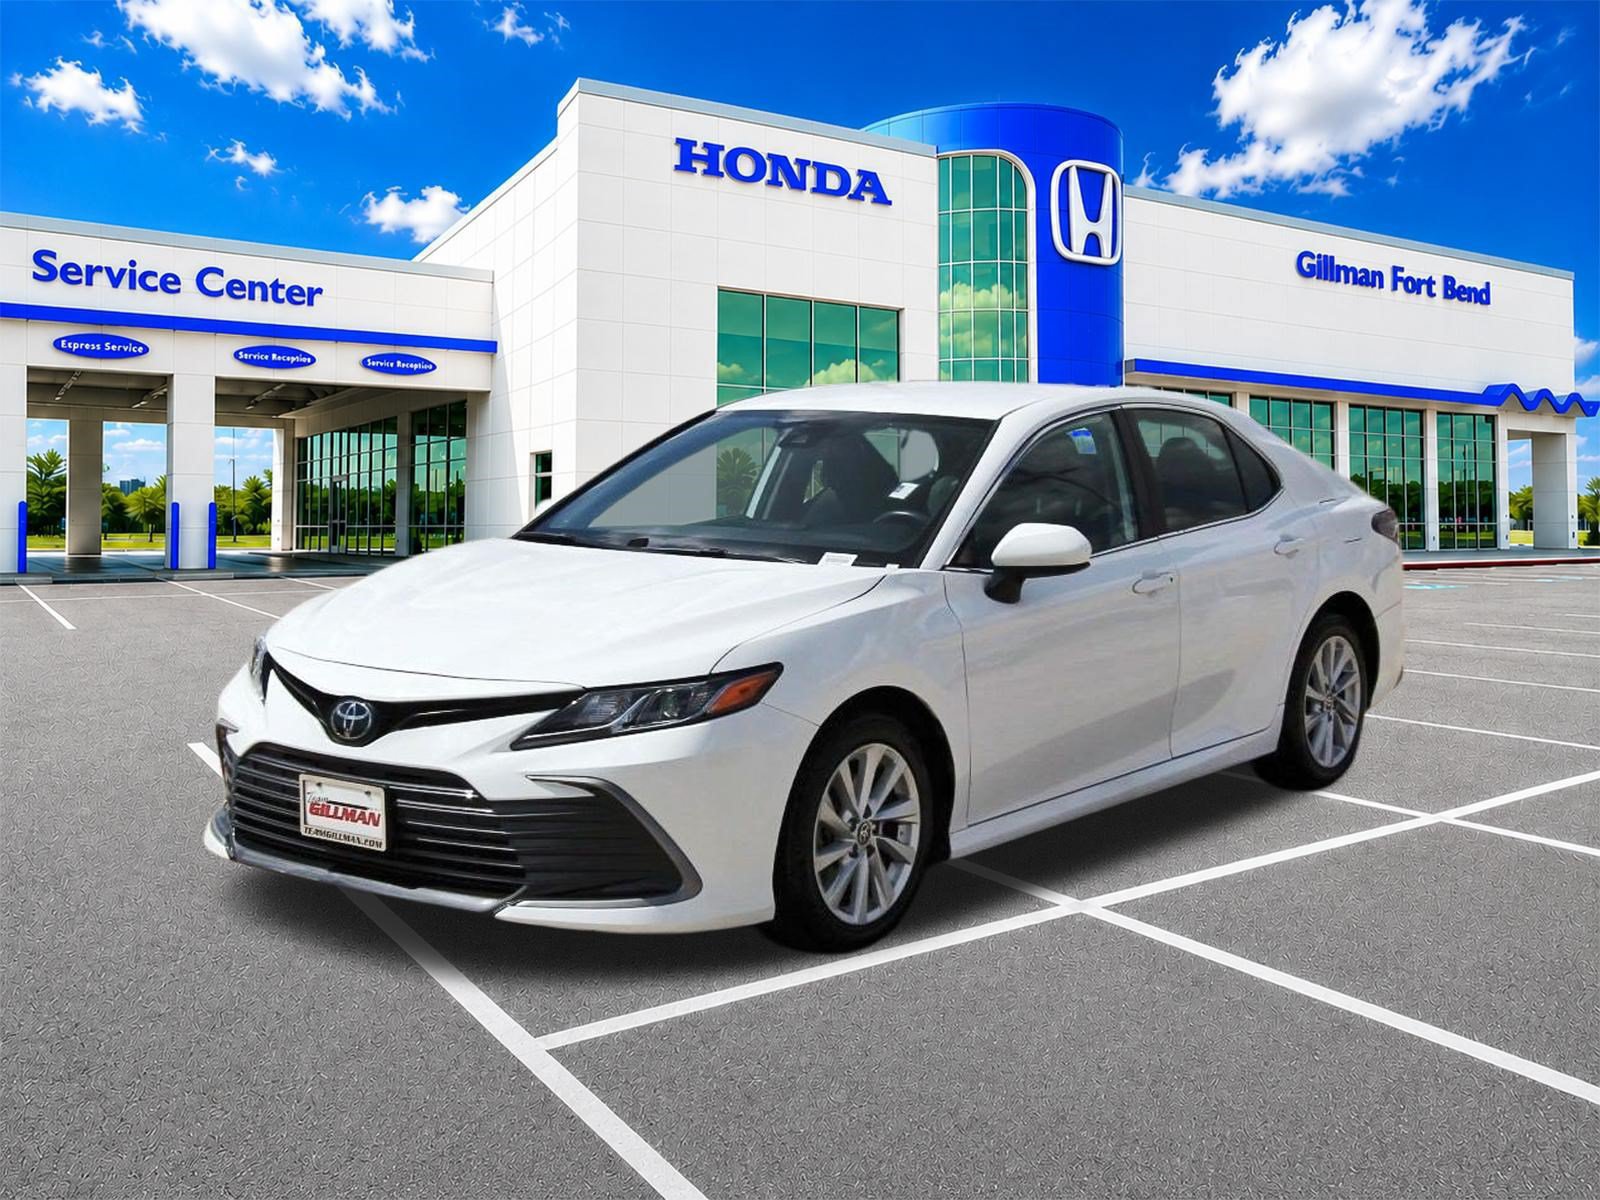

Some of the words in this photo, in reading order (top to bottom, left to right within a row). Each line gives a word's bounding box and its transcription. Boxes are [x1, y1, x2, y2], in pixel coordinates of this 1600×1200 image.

[673, 137, 892, 206] HONDA
[32, 249, 181, 294] Service
[195, 267, 323, 307] Center
[1296, 250, 1384, 289] Gillman
[1392, 265, 1436, 298] Fort
[1443, 275, 1491, 305] Bend
[104, 342, 144, 353] Service
[238, 351, 269, 361] Service
[367, 358, 394, 368] Service
[309, 801, 381, 827] GILLMAN
[304, 826, 383, 849] TEAMGILLMAN.COM
